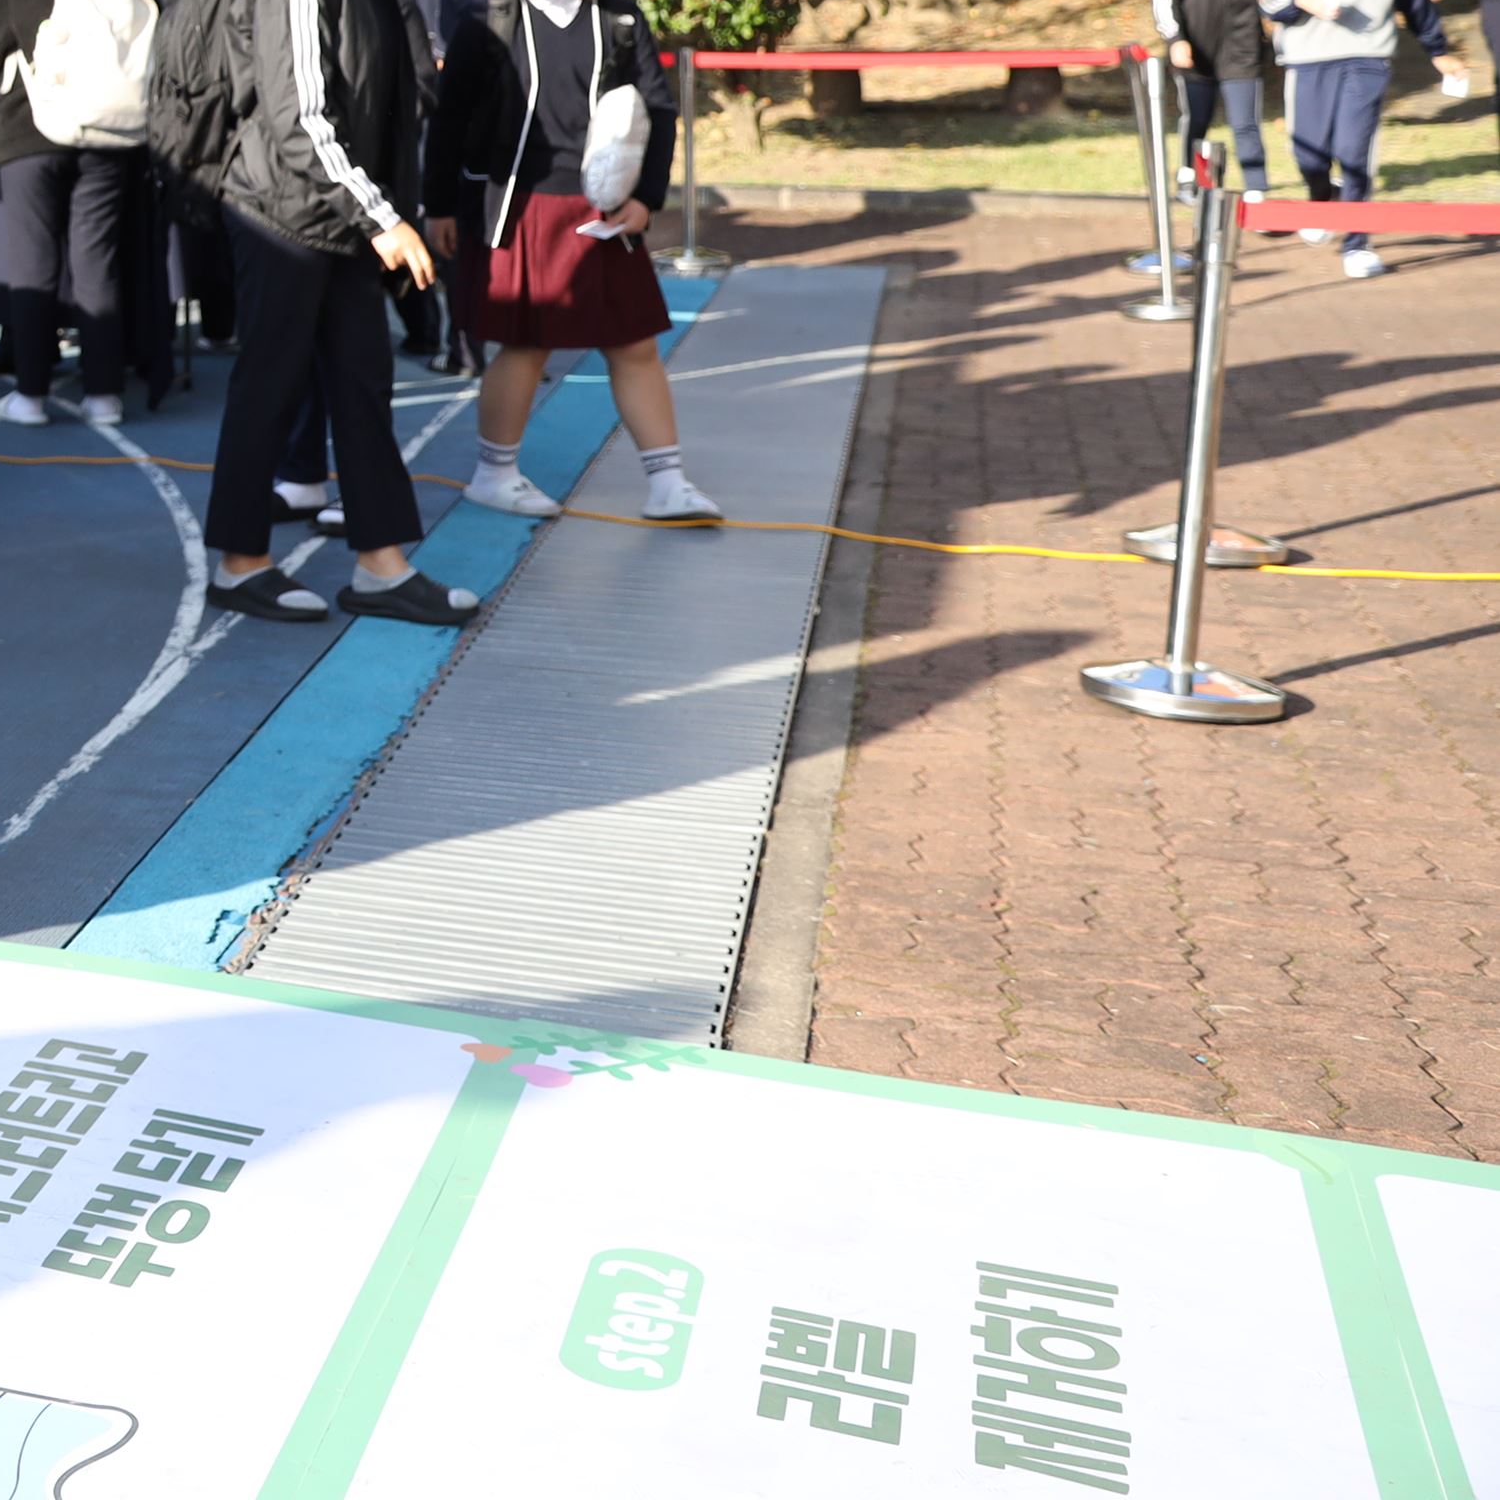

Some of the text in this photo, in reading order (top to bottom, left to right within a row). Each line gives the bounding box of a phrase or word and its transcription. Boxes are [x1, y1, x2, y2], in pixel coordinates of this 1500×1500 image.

[40, 1106, 267, 1288] 뚜껑 닫기
[584, 1258, 690, 1379] step.2
[756, 1305, 917, 1446] 라벨
[969, 1260, 1133, 1496] 제거하기
